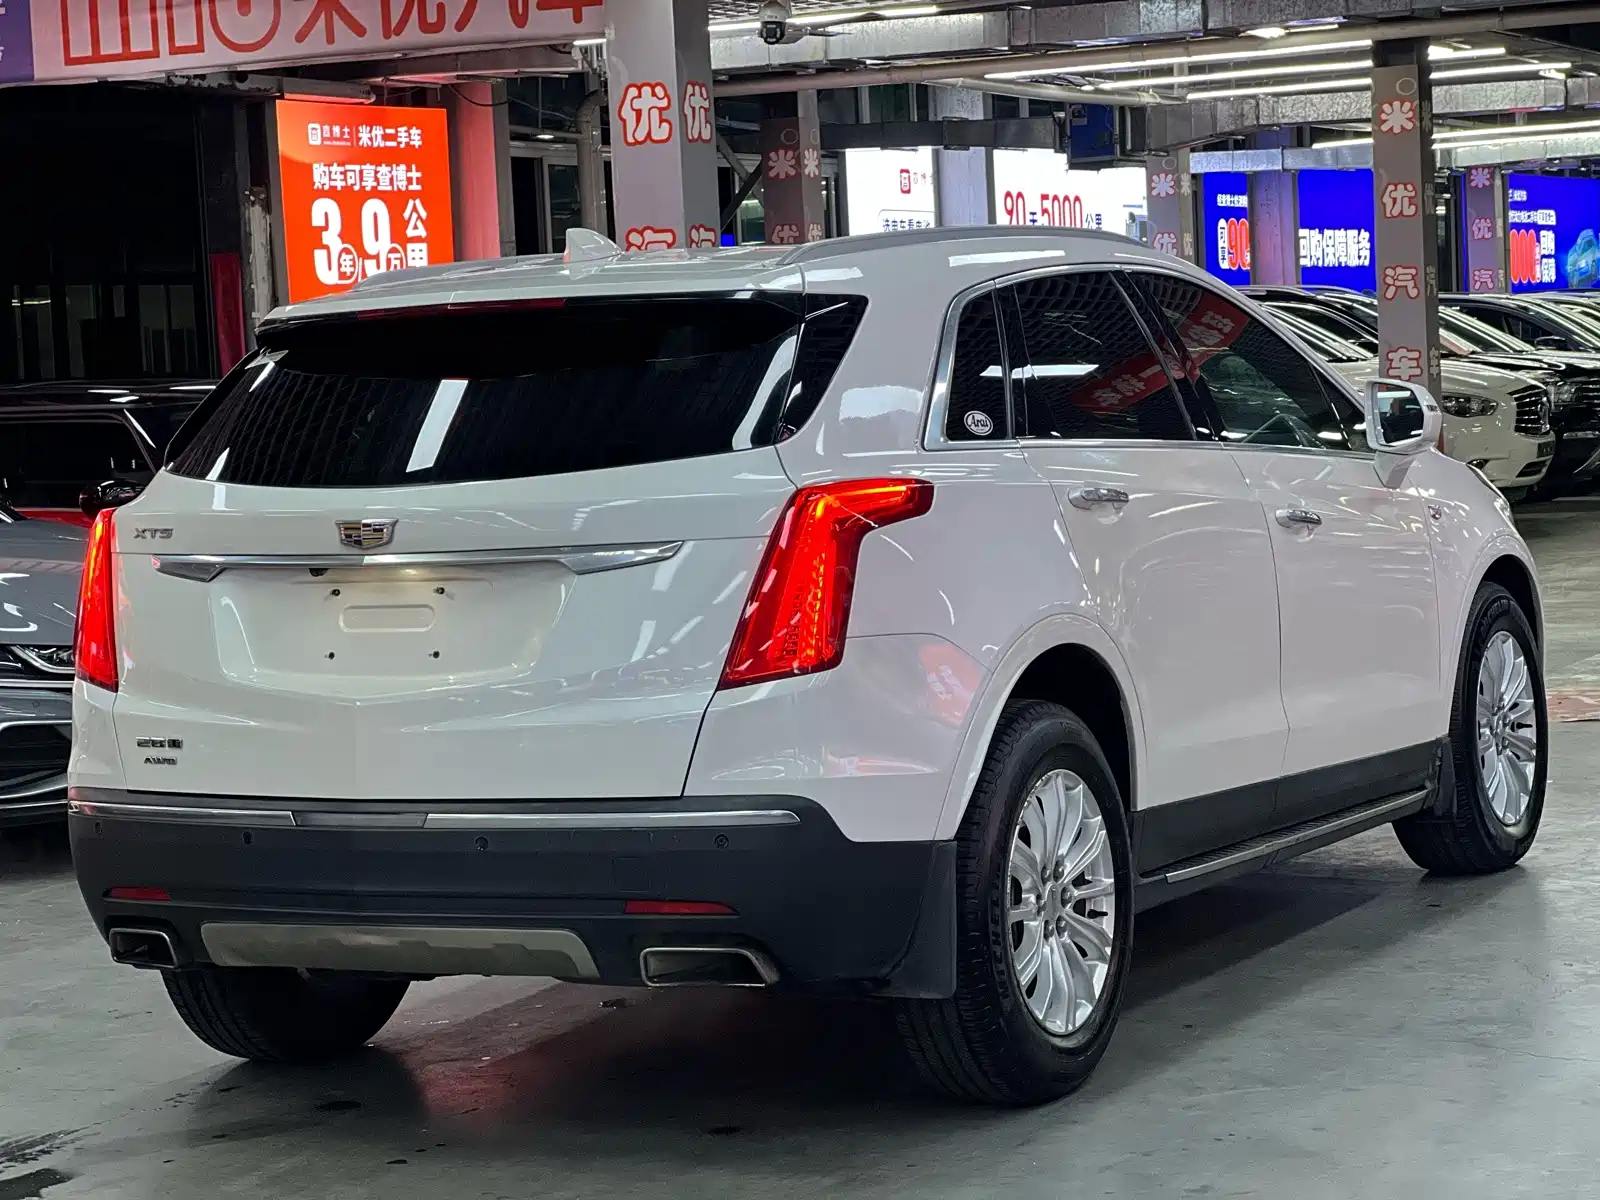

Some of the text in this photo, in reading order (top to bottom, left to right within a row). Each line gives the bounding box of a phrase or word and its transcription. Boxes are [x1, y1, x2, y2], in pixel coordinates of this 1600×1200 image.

[358, 124, 422, 149] 米优二手车
[312, 163, 422, 191] 购车可享查博士
[1299, 228, 1370, 267] 回购保障服务
[1379, 100, 1422, 380] 米优汽车
